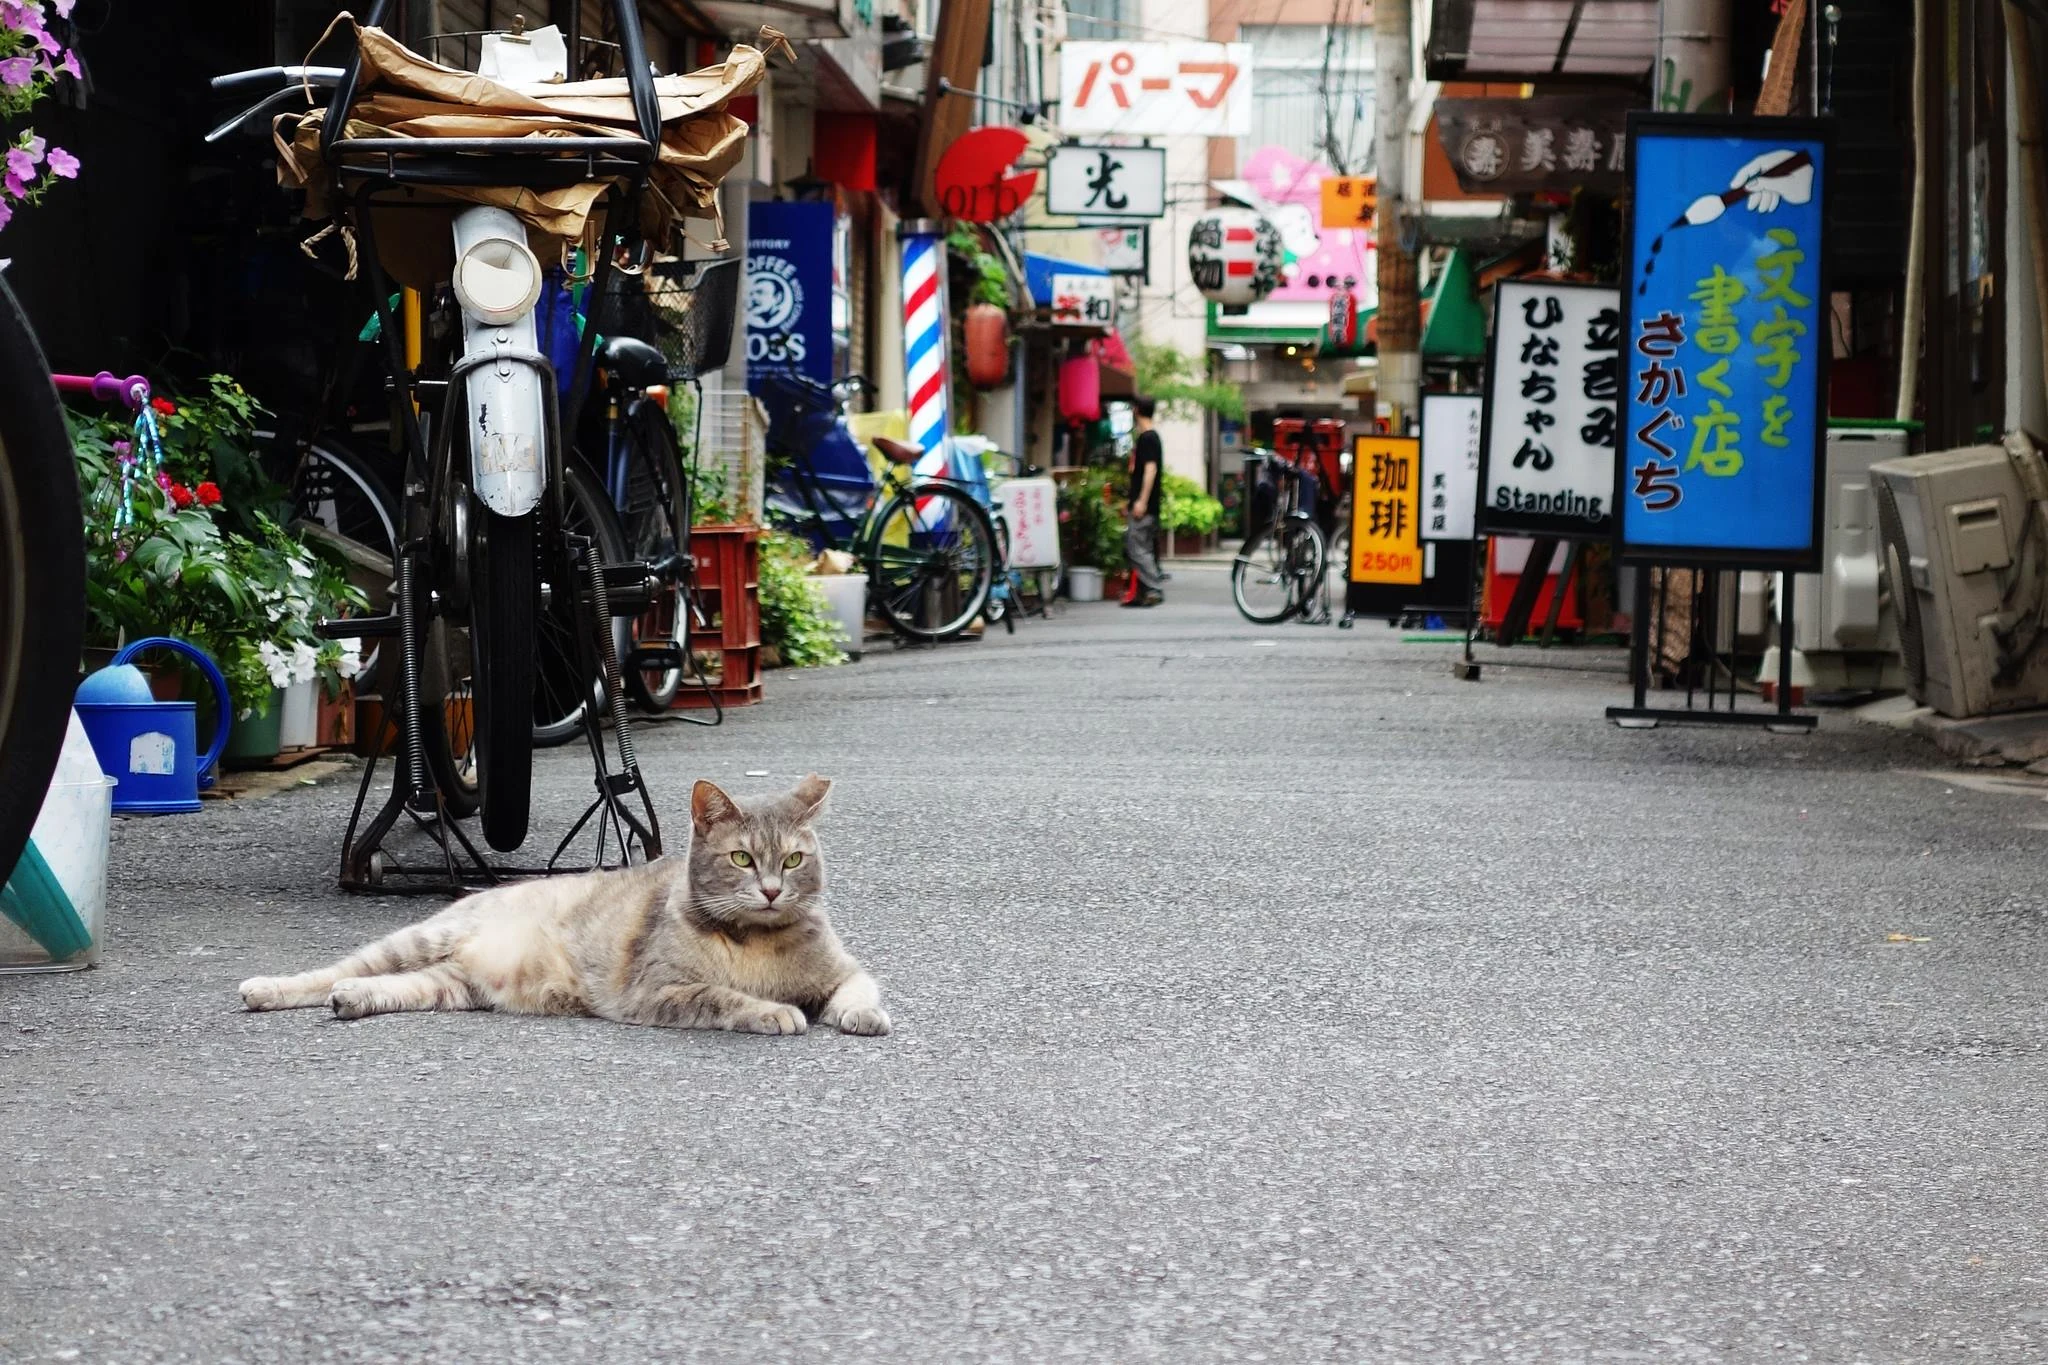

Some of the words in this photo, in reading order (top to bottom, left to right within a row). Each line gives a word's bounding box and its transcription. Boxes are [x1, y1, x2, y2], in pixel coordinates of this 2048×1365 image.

[1073, 51, 1239, 108] パーマ
[1083, 151, 1129, 209] 光
[1511, 296, 1563, 472] ひなちゃん
[1682, 263, 1749, 477] 書く店
[1750, 228, 1812, 447] 文字を
[1633, 310, 1688, 512] さかぐち
[1369, 452, 1409, 539] 珈琲
[1496, 486, 1604, 521] Standing
